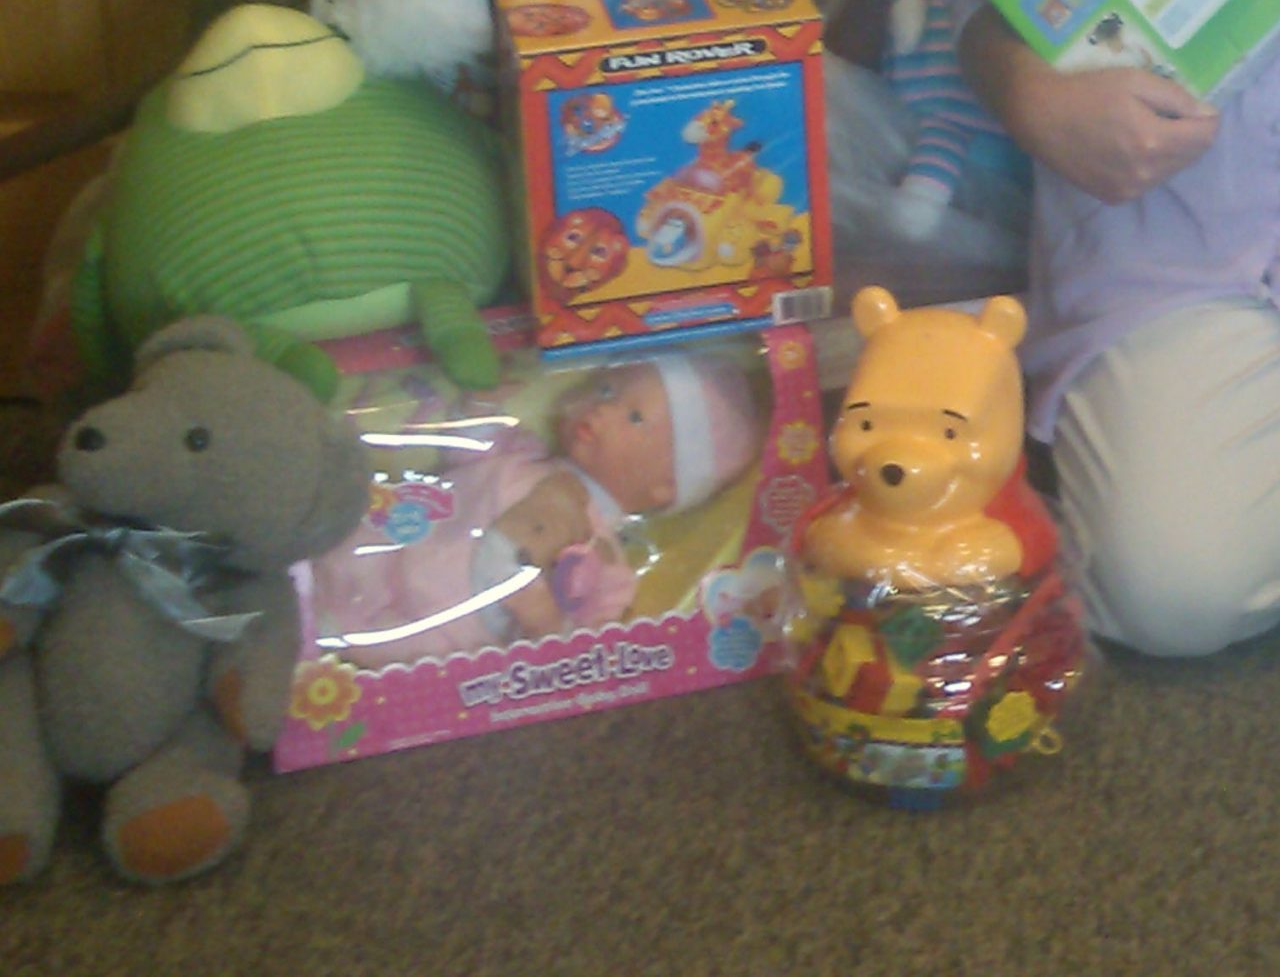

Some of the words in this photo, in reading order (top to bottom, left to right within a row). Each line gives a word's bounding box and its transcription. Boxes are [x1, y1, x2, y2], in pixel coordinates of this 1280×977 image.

[608, 52, 662, 71] FUN
[664, 41, 756, 64] ROVER
[507, 642, 608, 700] Sweet
[613, 640, 675, 679] Love
